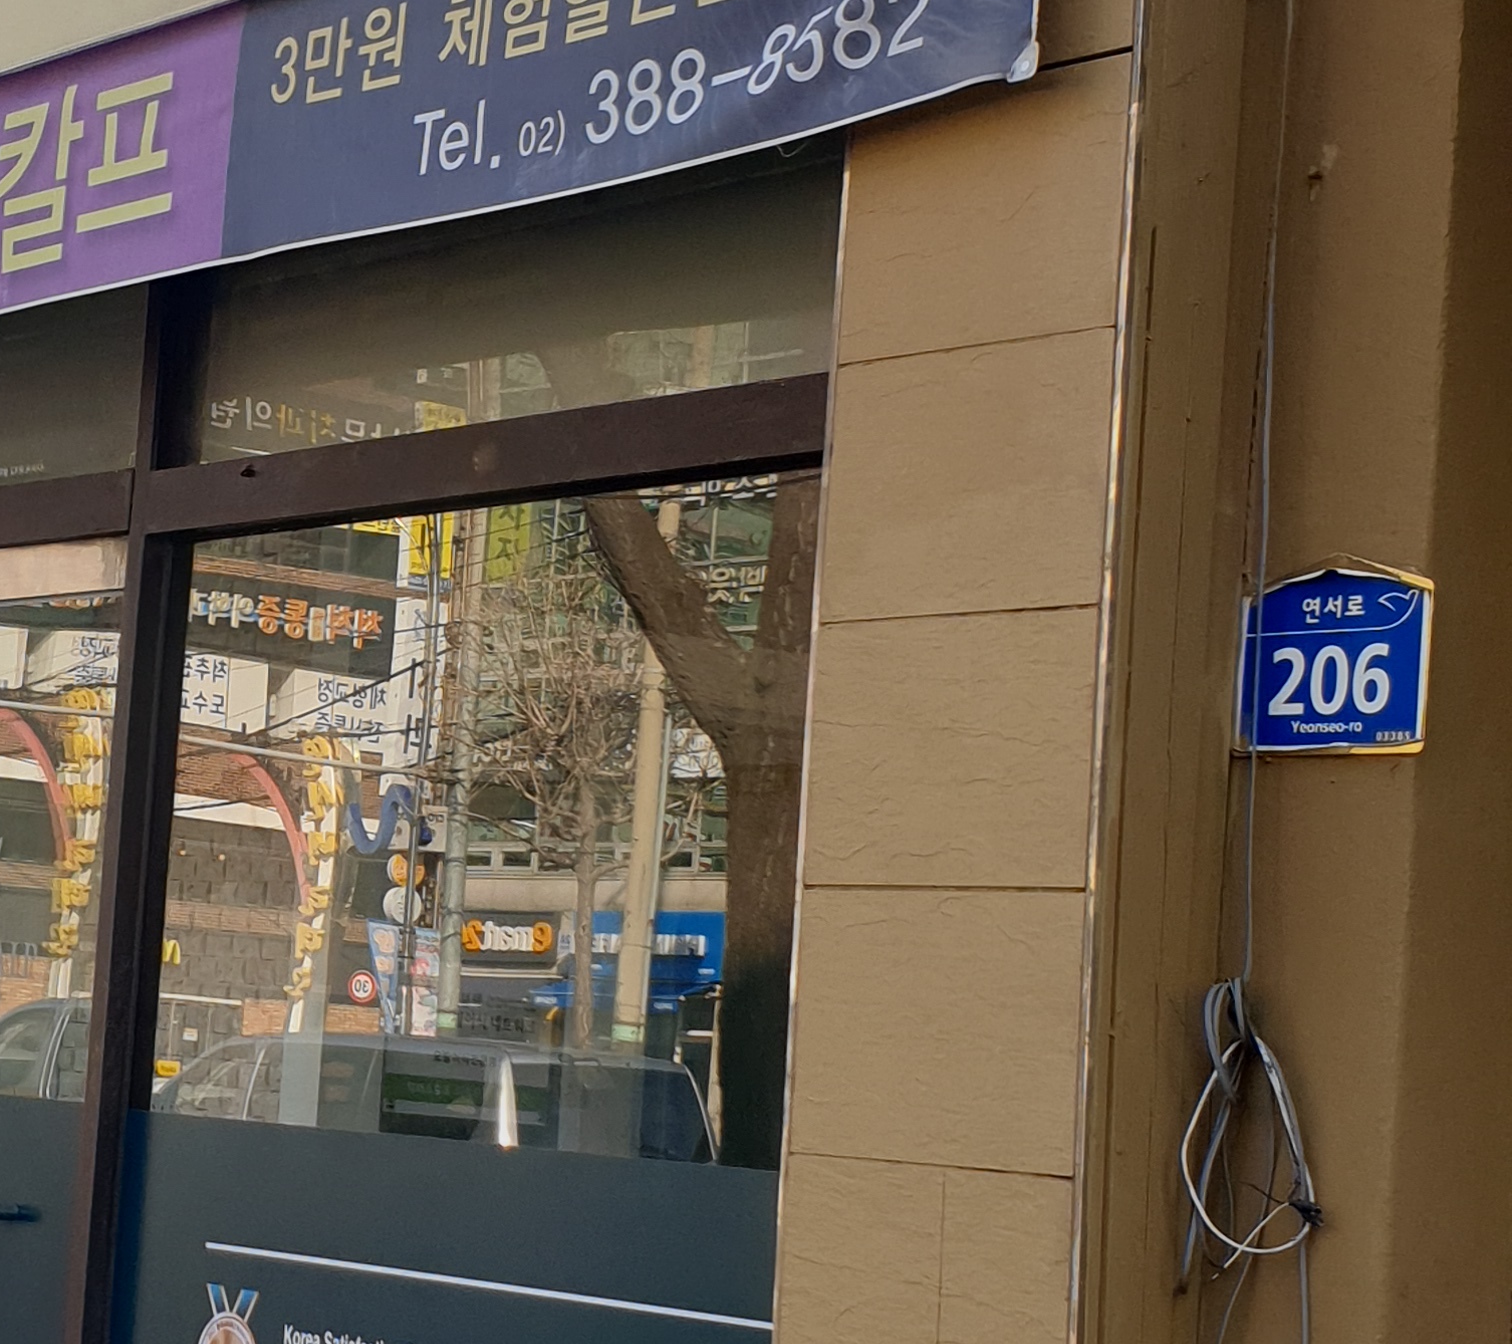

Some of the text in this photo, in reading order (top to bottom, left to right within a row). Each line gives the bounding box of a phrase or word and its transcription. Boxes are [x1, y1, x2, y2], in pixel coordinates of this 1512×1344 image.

[269, 1, 409, 106] 3만원
[413, 99, 501, 177] Tel.
[517, 110, 566, 160] 02)
[1302, 595, 1366, 624] 연서로
[1267, 642, 1390, 716] 206
[1291, 720, 1363, 734] Yeonseo-ro
